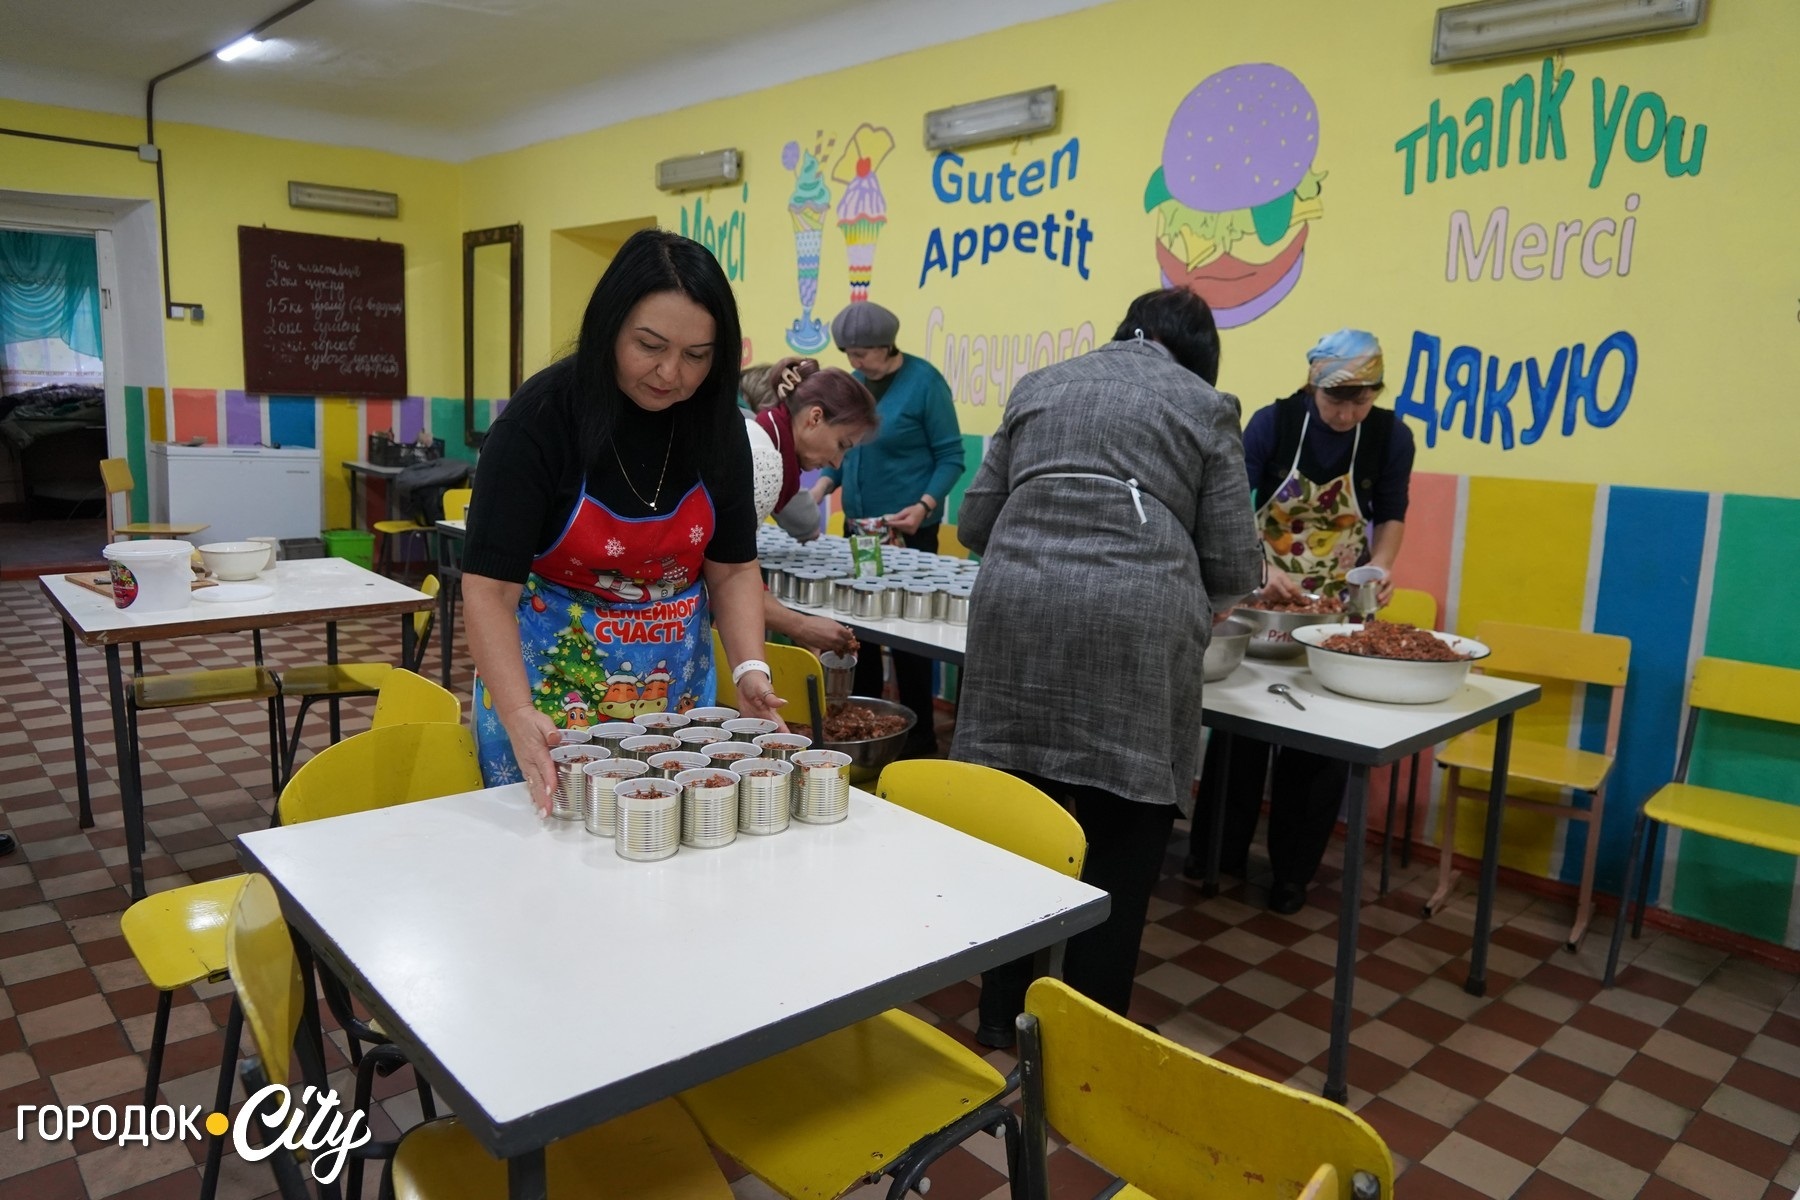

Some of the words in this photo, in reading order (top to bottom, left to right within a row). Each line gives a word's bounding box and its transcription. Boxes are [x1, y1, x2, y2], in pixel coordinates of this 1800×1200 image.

[1395, 57, 1575, 194] Thank
[1589, 78, 1707, 189] you
[931, 137, 1080, 204] Guten
[918, 209, 1094, 289] Appetit
[1445, 193, 1641, 282] Merci
[1394, 331, 1639, 451] ДЯКУЮ
